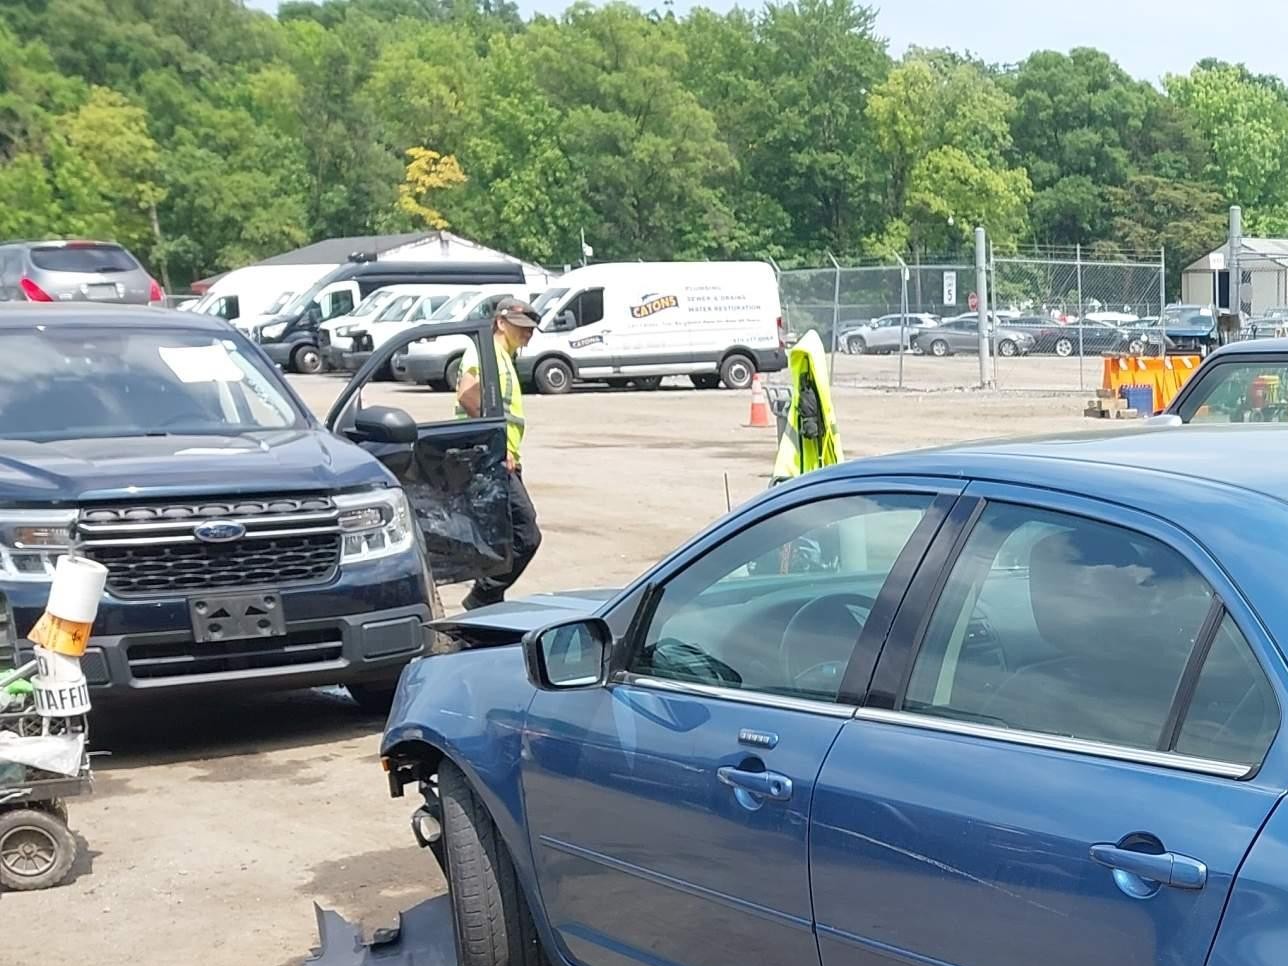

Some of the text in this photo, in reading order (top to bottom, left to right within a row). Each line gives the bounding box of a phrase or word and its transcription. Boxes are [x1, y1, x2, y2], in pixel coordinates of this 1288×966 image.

[947, 289, 953, 302] 5
[632, 295, 677, 318] CATONS
[571, 336, 601, 348] CATONS
